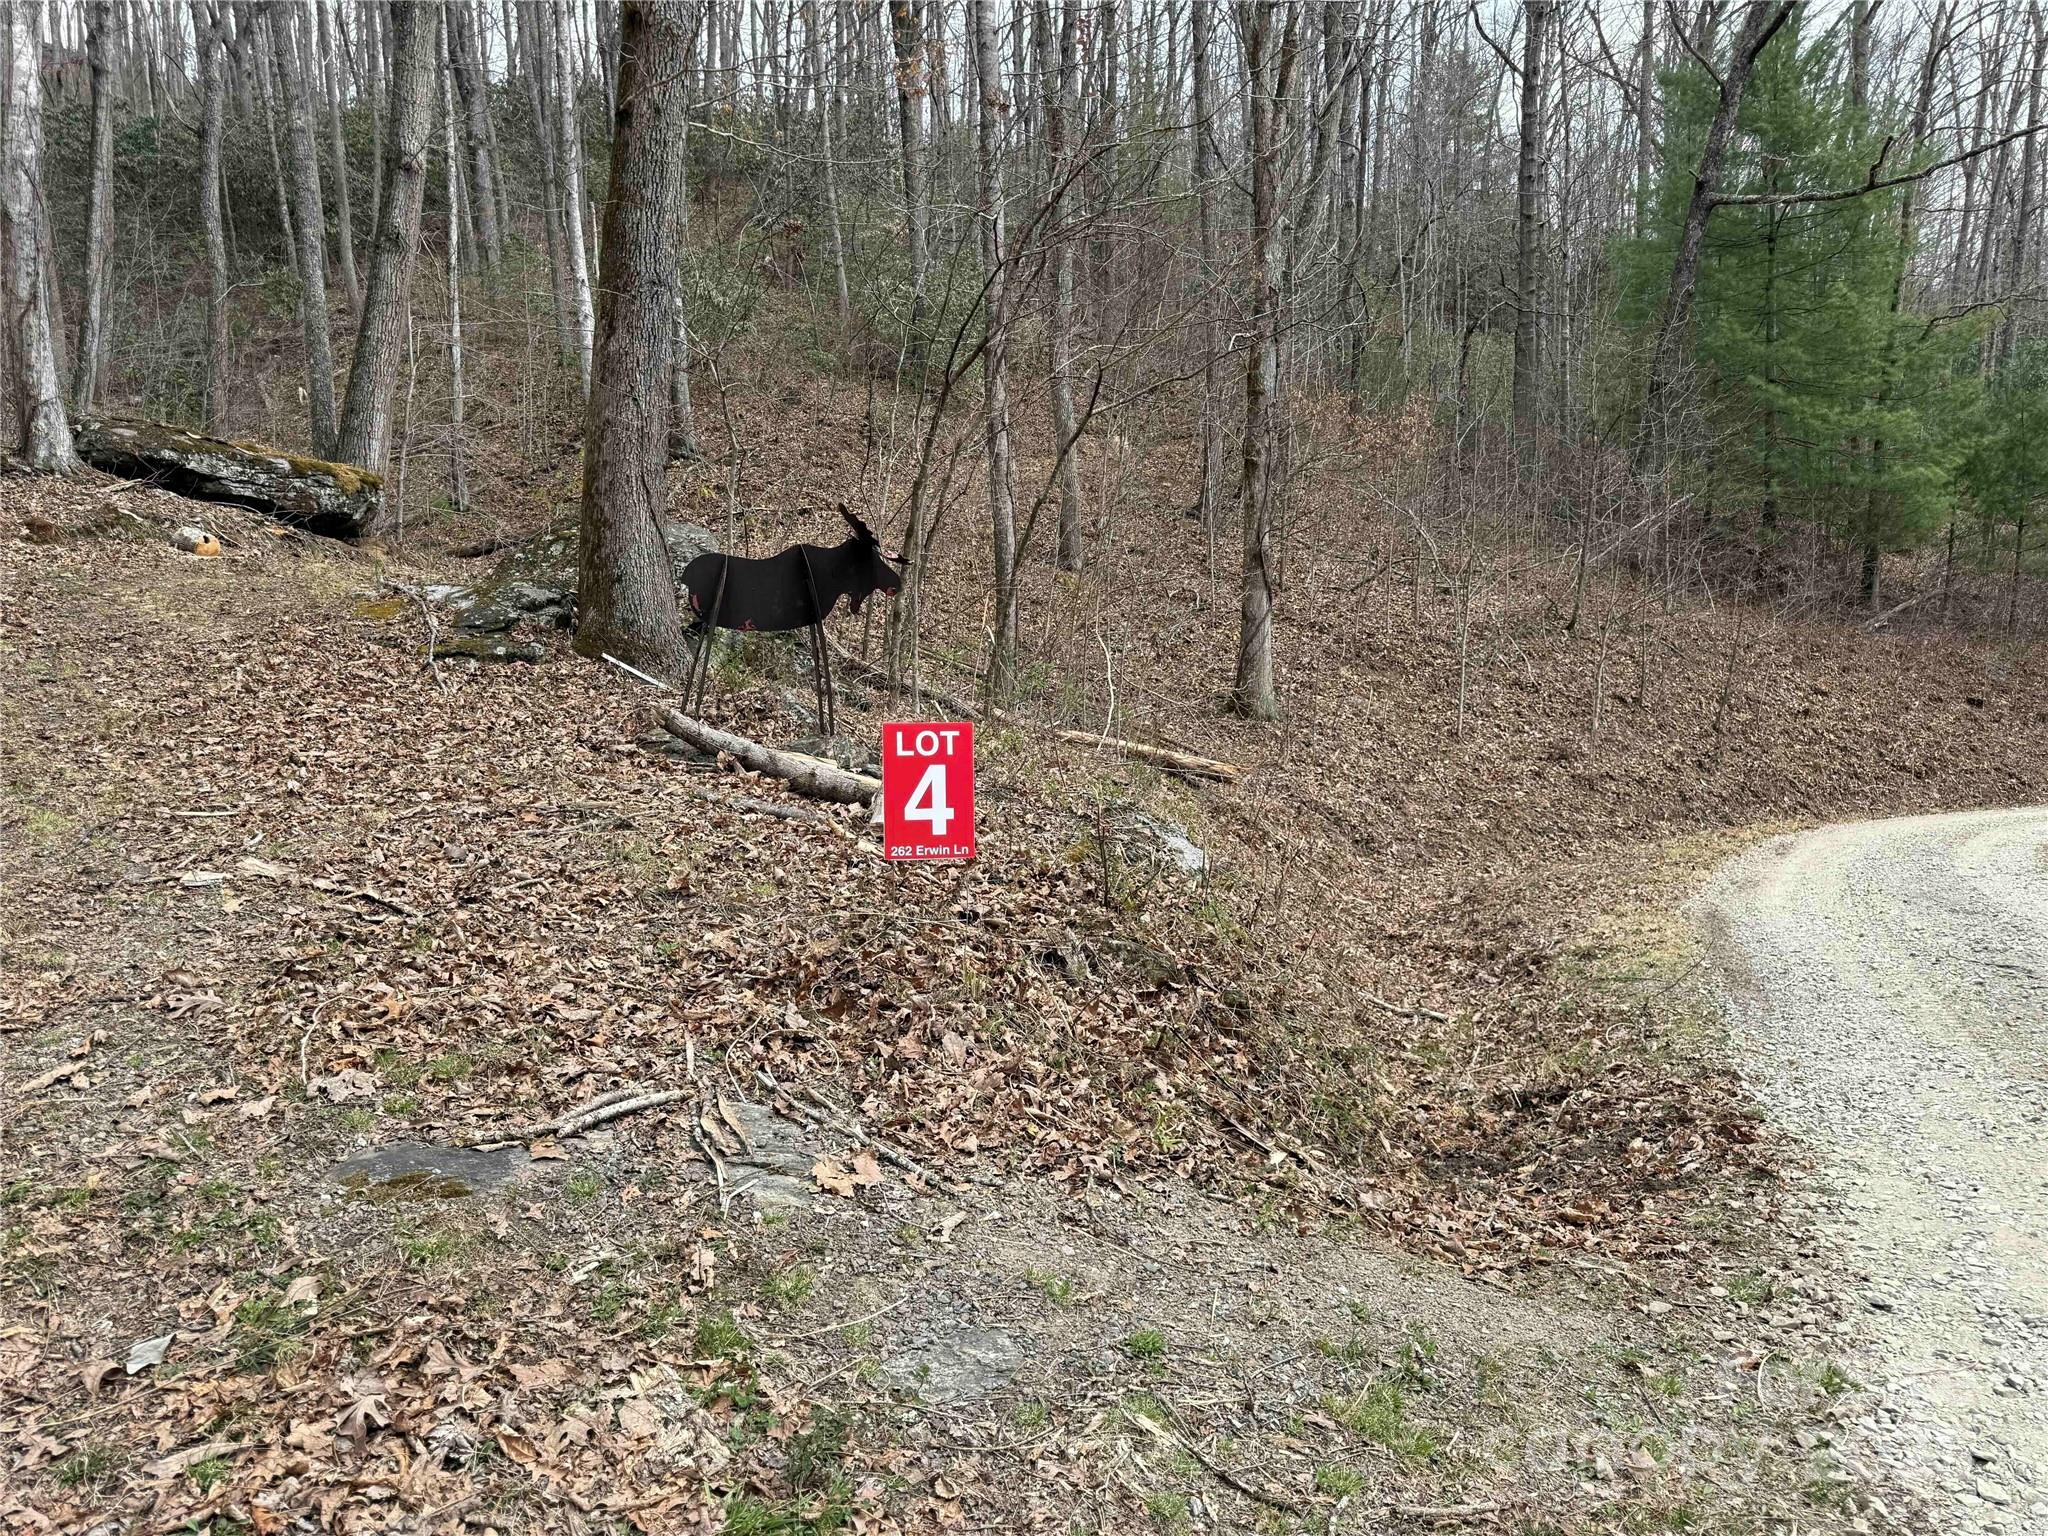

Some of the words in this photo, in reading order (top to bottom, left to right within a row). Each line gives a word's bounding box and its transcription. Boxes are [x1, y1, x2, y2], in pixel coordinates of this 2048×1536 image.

[896, 731, 960, 756] LOT
[904, 764, 955, 836] 4
[890, 845, 913, 857] 262
[916, 845, 950, 856] Erwin
[954, 844, 969, 855] Ln
